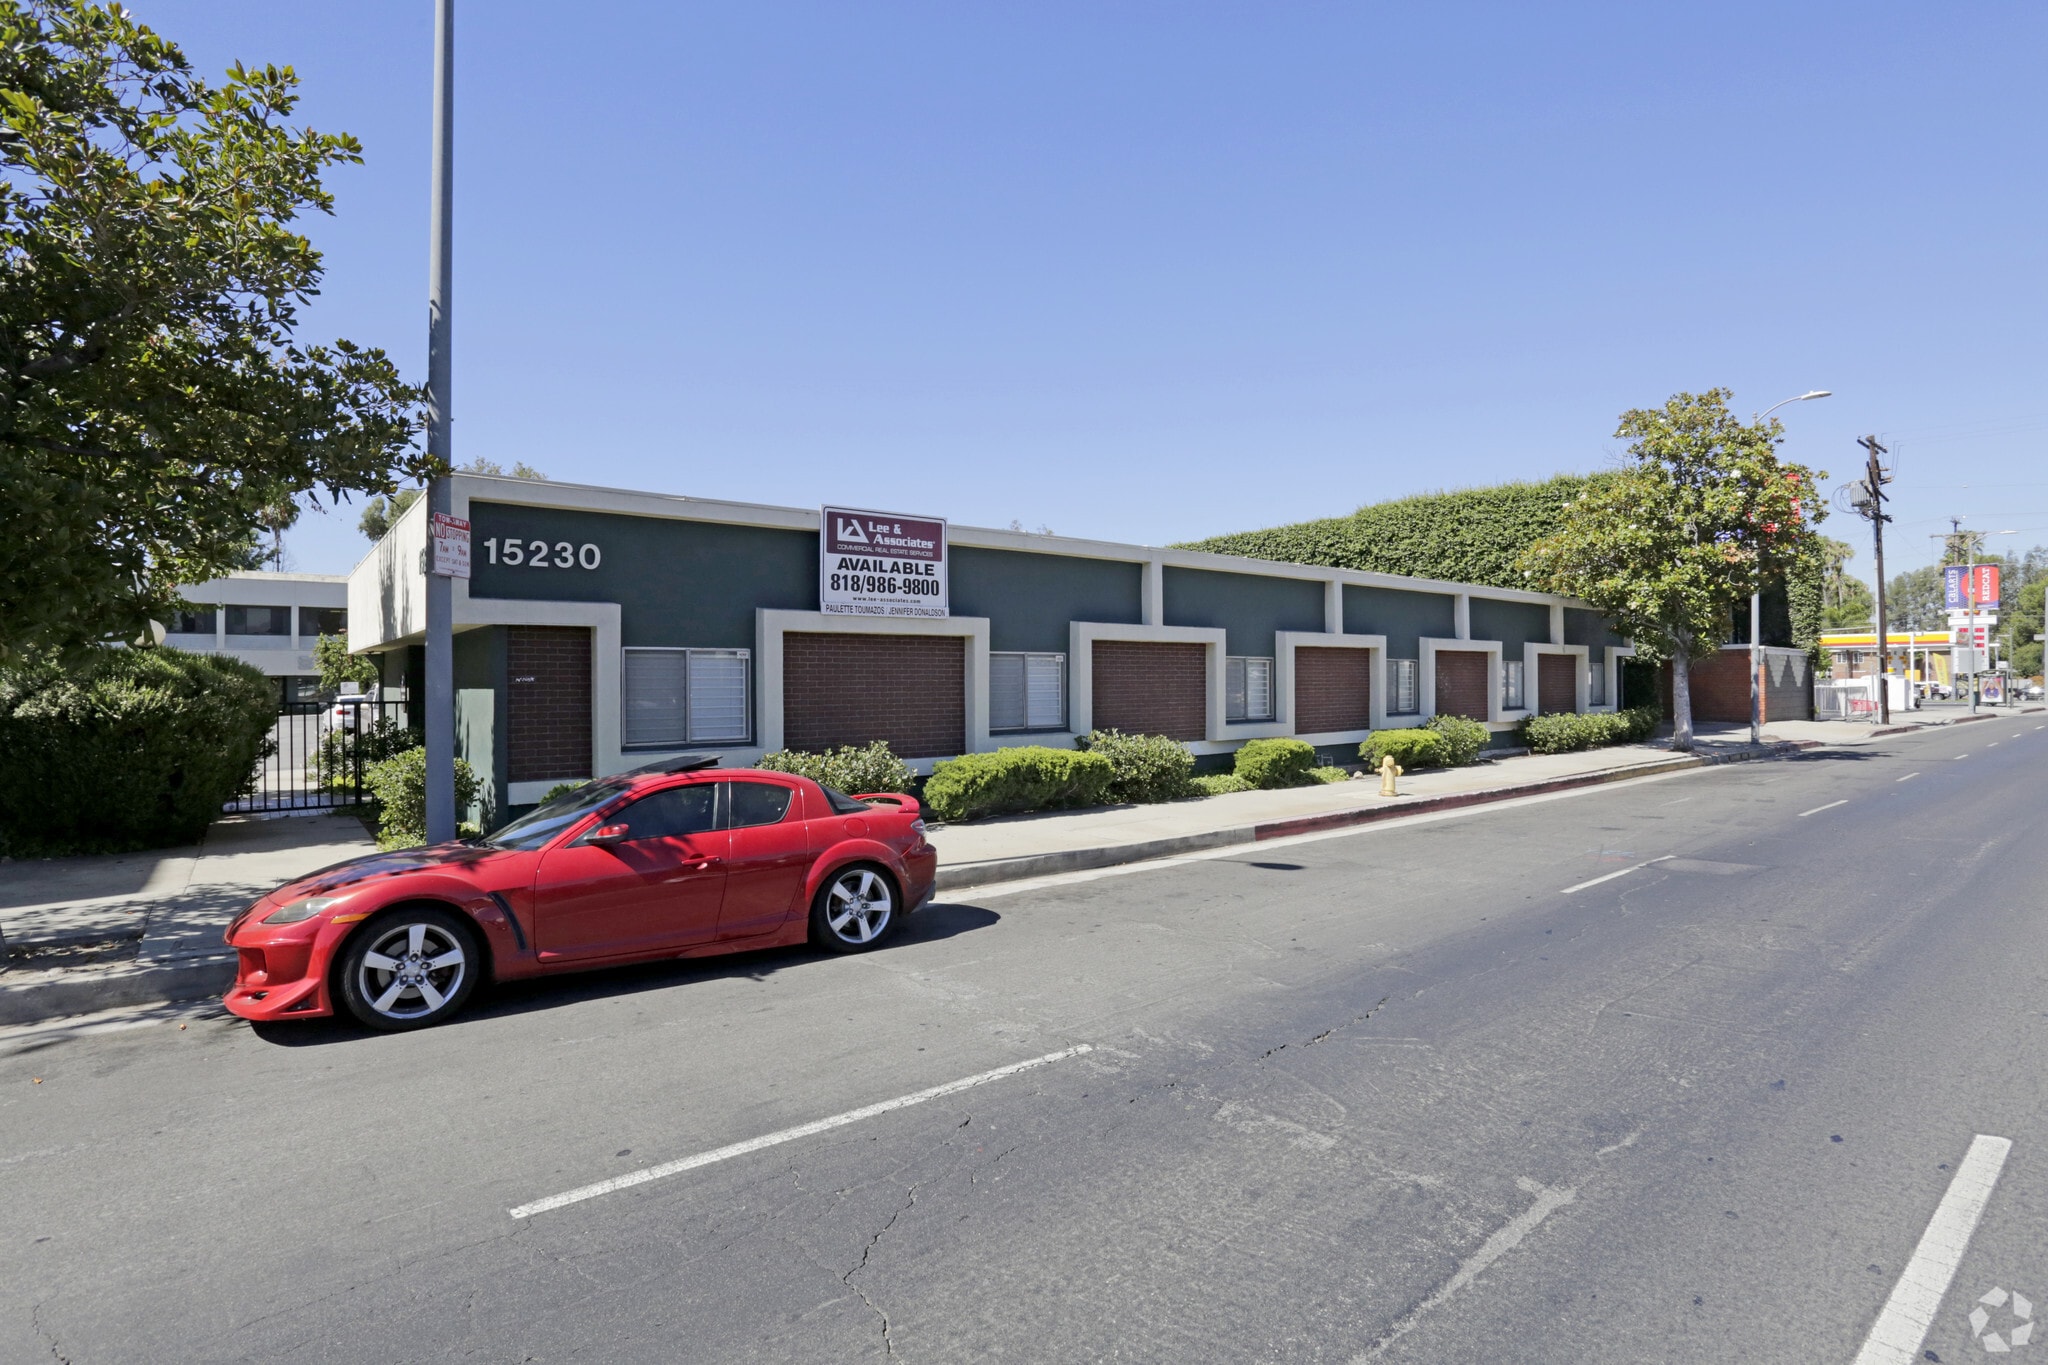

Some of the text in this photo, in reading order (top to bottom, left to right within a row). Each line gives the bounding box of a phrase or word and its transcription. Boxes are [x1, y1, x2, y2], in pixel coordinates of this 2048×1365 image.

[435, 522, 470, 543] NO STOPPING
[868, 521, 902, 535] Lee &
[873, 533, 934, 549] Associates
[483, 537, 601, 570] 15230
[837, 544, 934, 557] COMMERCIAL REAL ESTATE SERVICES
[837, 557, 935, 576] AVAILABLE
[830, 573, 940, 596] 818/986-9800
[1982, 567, 1990, 602] REDCAT
[852, 596, 921, 604] www.lee-associates.com
[825, 604, 946, 617] PAULETTE TOUMAZOS JENNIFER DONALDSON
